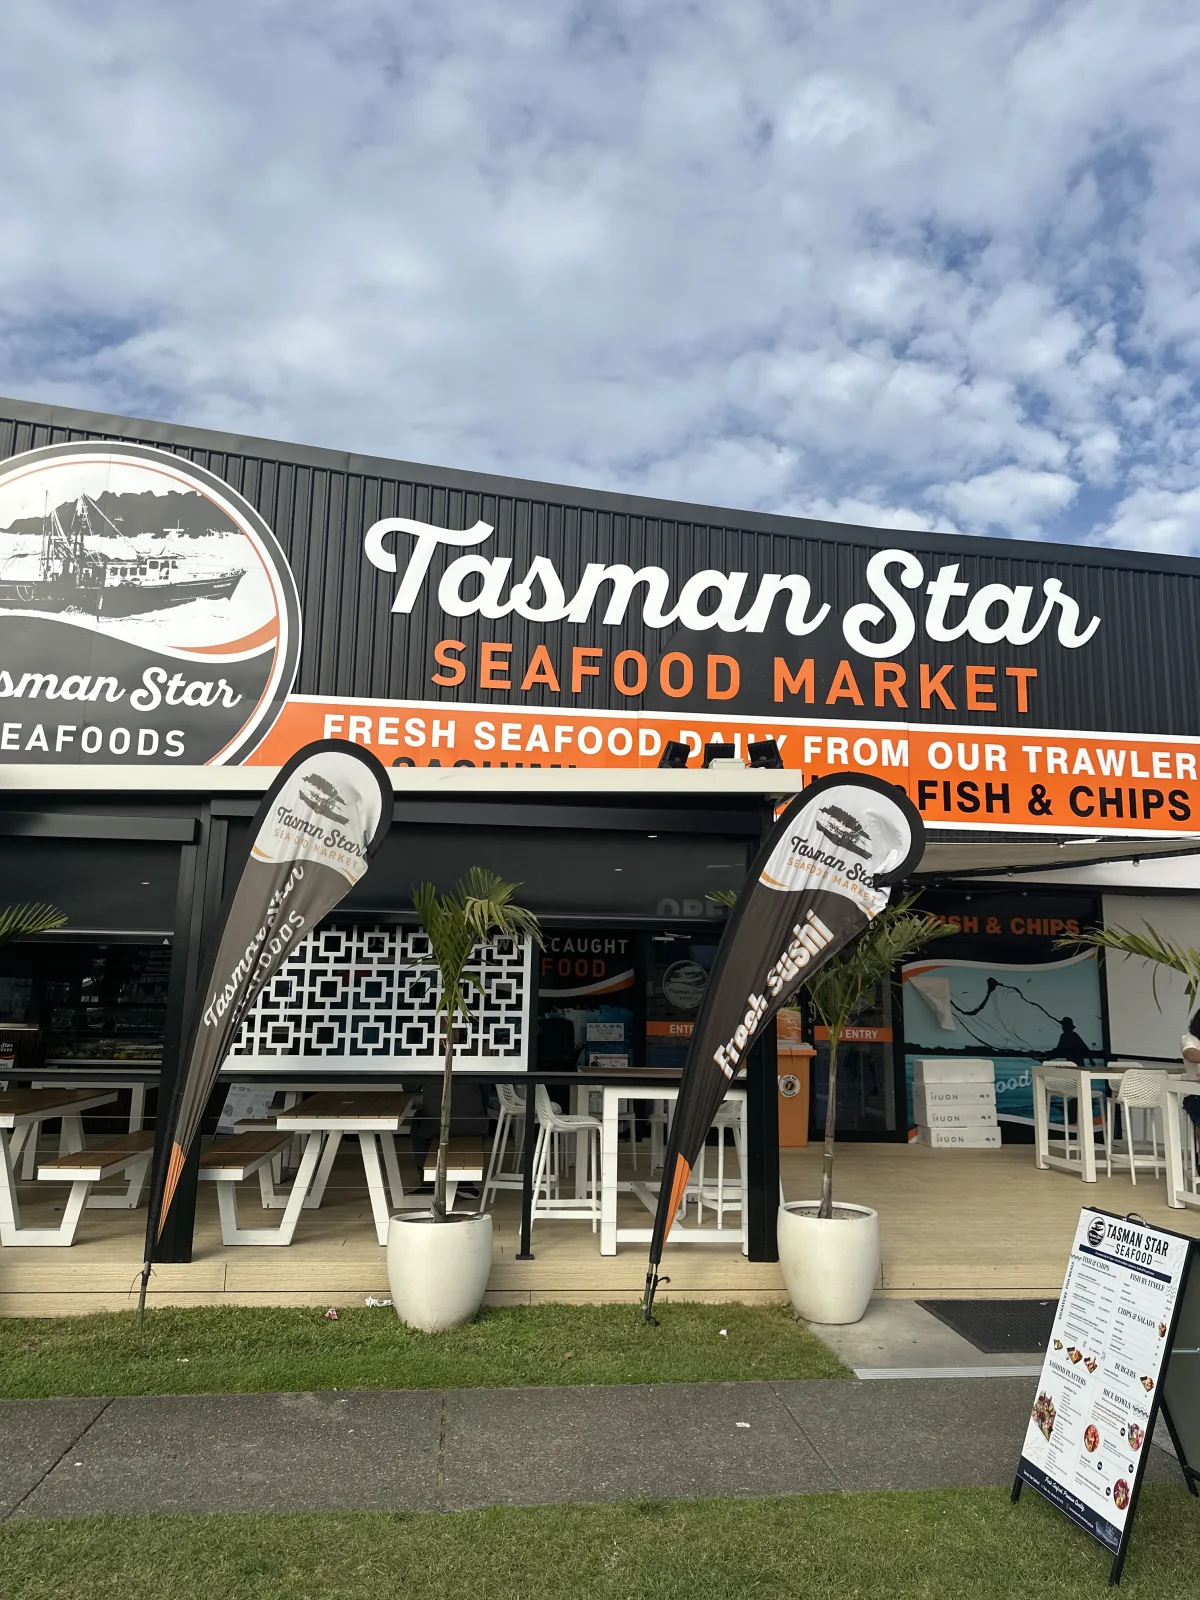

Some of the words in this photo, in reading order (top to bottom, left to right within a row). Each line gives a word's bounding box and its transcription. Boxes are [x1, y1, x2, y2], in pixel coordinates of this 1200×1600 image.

[364, 517, 831, 636] Tasman
[843, 548, 1101, 659] Star
[130, 666, 242, 711] Star
[431, 639, 741, 701] SEAFOOD
[773, 656, 1038, 713] MARKET
[0, 722, 186, 757] EAFOODS
[323, 713, 456, 749] FRESH
[473, 719, 661, 757] SEAFOOD
[803, 735, 909, 767] FROM
[927, 741, 1007, 772] OUR
[1022, 745, 1198, 780] TRAWLER
[917, 779, 1010, 815] FISH
[1027, 783, 1054, 816] &
[1069, 785, 1192, 821] CHIPS
[790, 835, 846, 872] Tasman
[832, 874, 879, 905] MARKET
[985, 916, 1003, 935] &
[1009, 916, 1081, 937] CHIPS
[550, 937, 629, 955] CAUGHT
[713, 992, 769, 1080] Fresh
[845, 1029, 879, 1040] ENTRY
[1106, 1223, 1143, 1248] TASMAN
[1144, 1235, 1169, 1257] STAR
[1114, 1243, 1153, 1266] SEAFOOD
